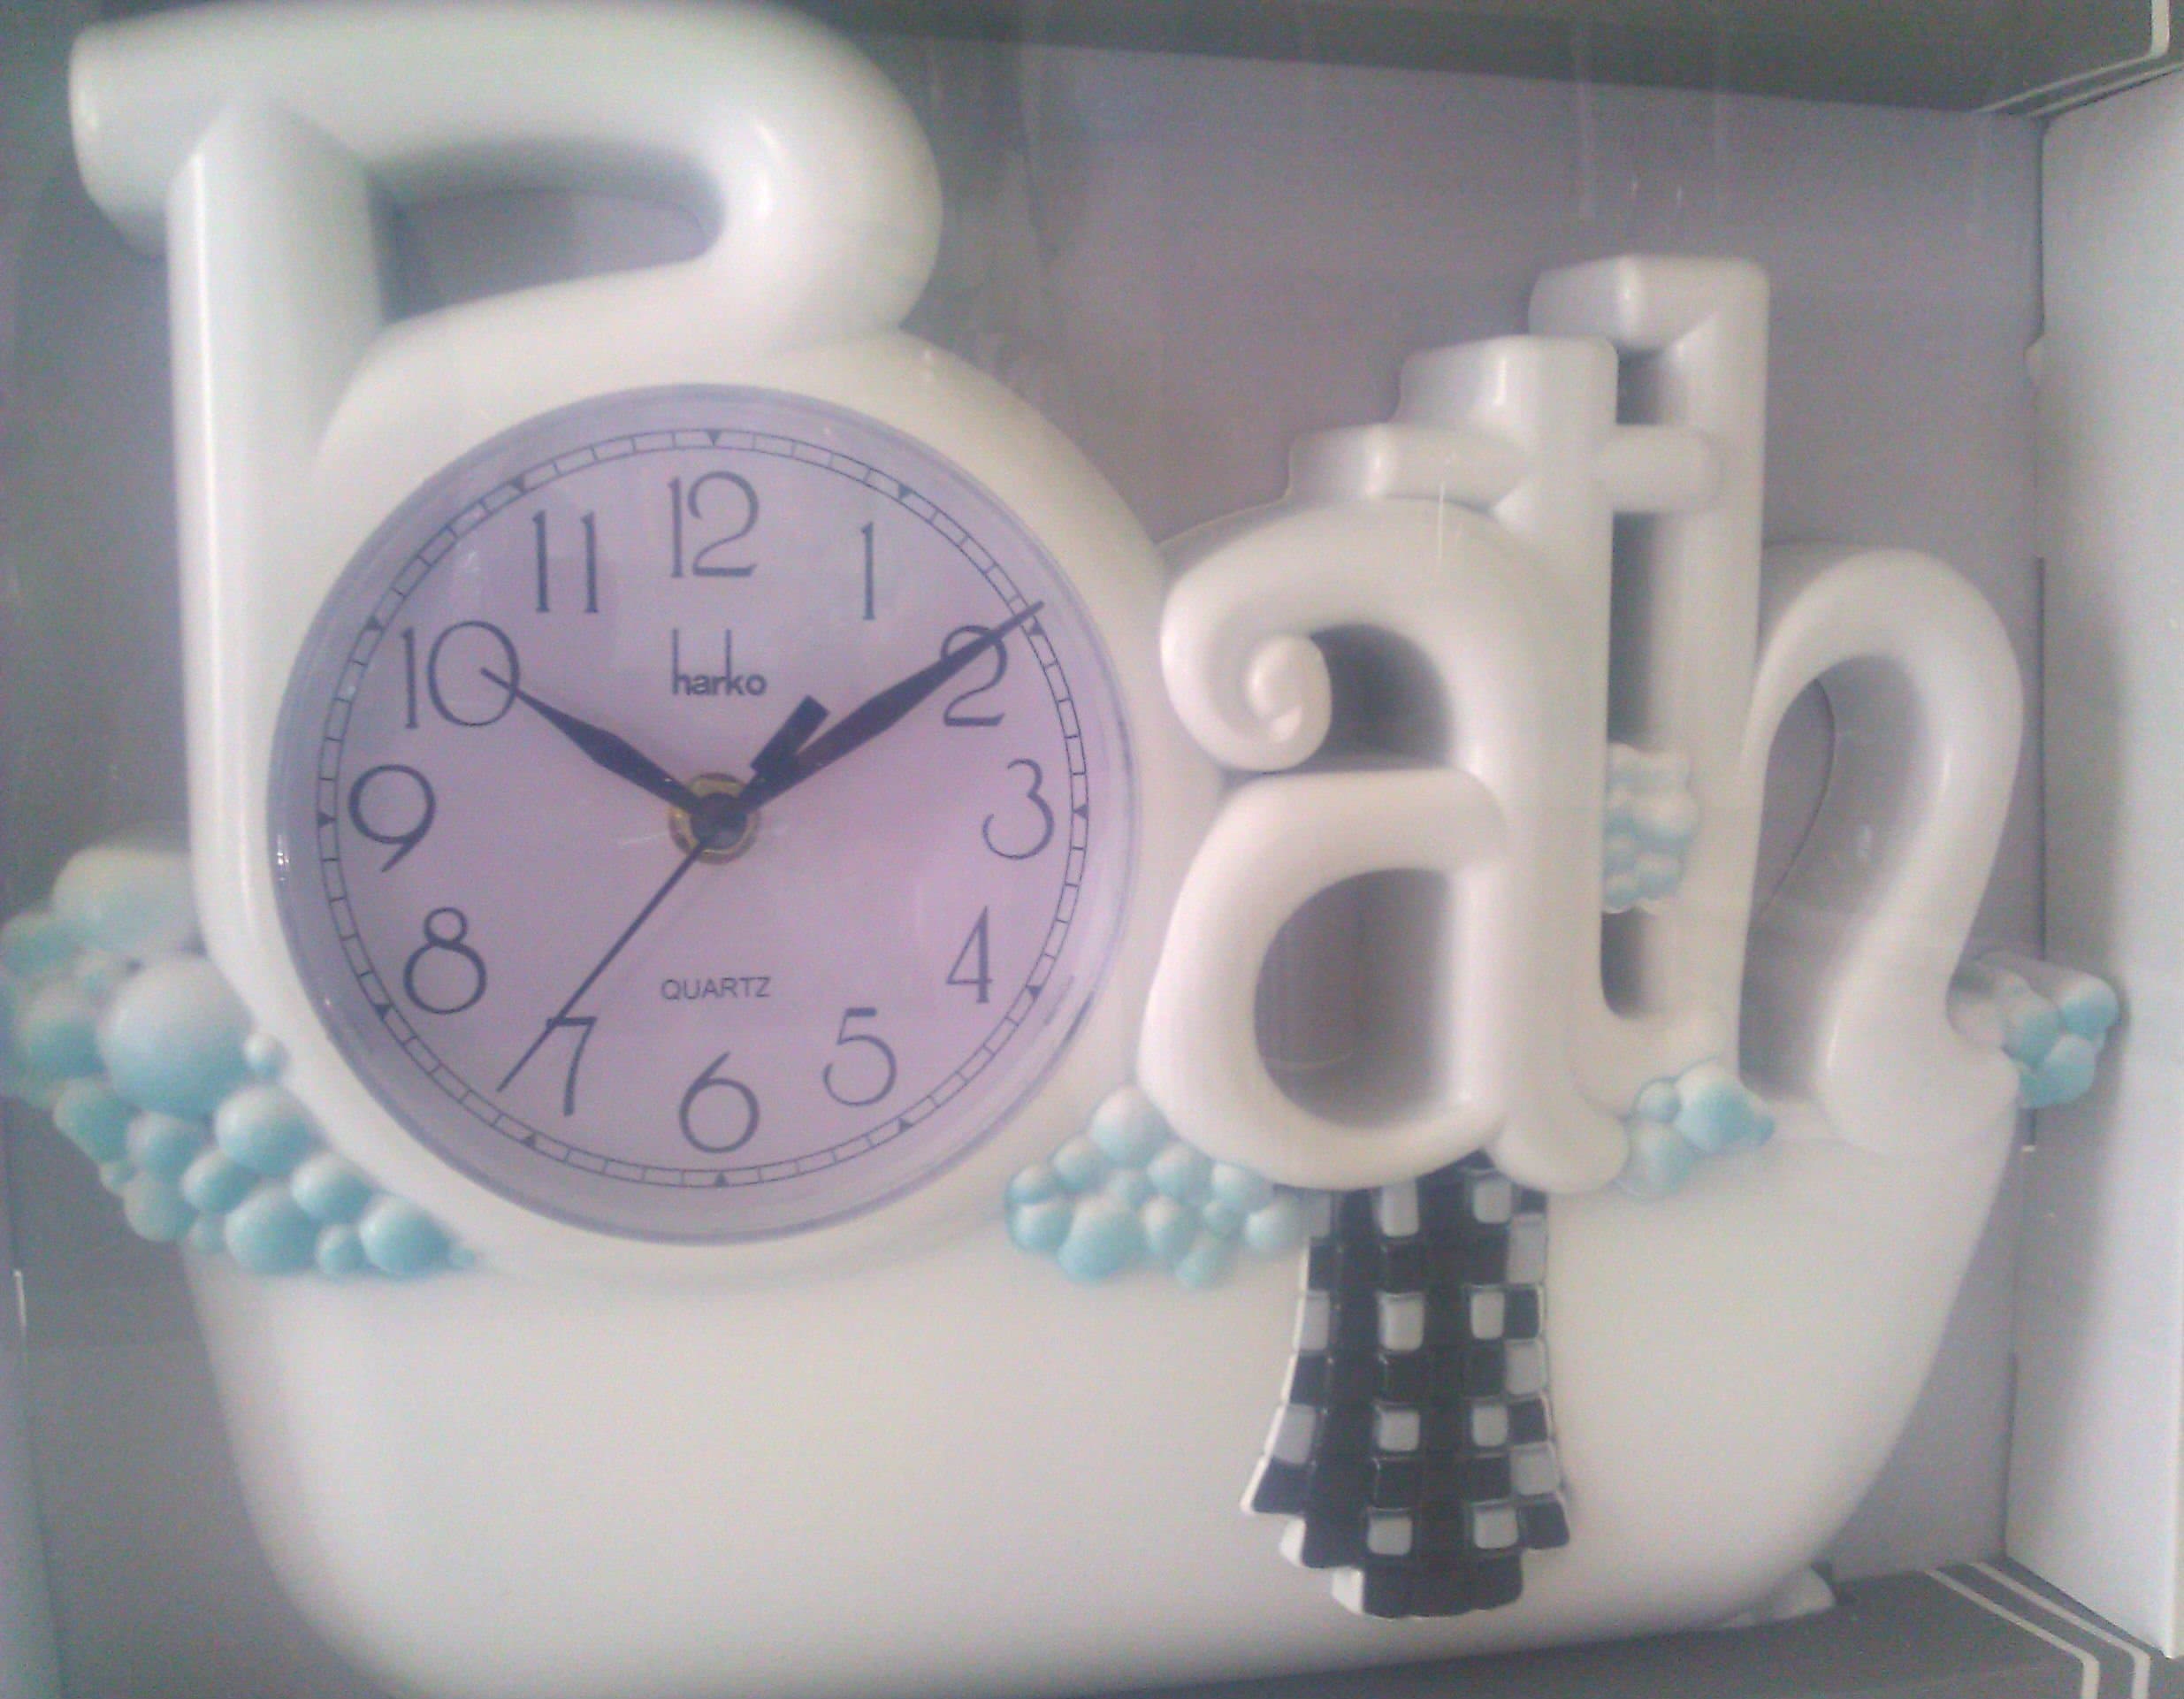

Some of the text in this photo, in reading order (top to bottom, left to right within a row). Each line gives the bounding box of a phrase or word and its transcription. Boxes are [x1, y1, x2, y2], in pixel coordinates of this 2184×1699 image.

[532, 509, 599, 614] 11
[668, 471, 760, 579] 12
[859, 521, 877, 622] 1
[401, 620, 521, 729] 10
[672, 629, 767, 696] harko
[939, 624, 1009, 727] 2
[347, 764, 436, 874] 9
[981, 758, 1055, 861] 3
[403, 907, 487, 1015] 8
[661, 976, 772, 1001] QUARTZ
[945, 905, 992, 1005] 4
[546, 1016, 598, 1117] 7
[679, 1050, 760, 1153] 6
[823, 1006, 897, 1107] 5
